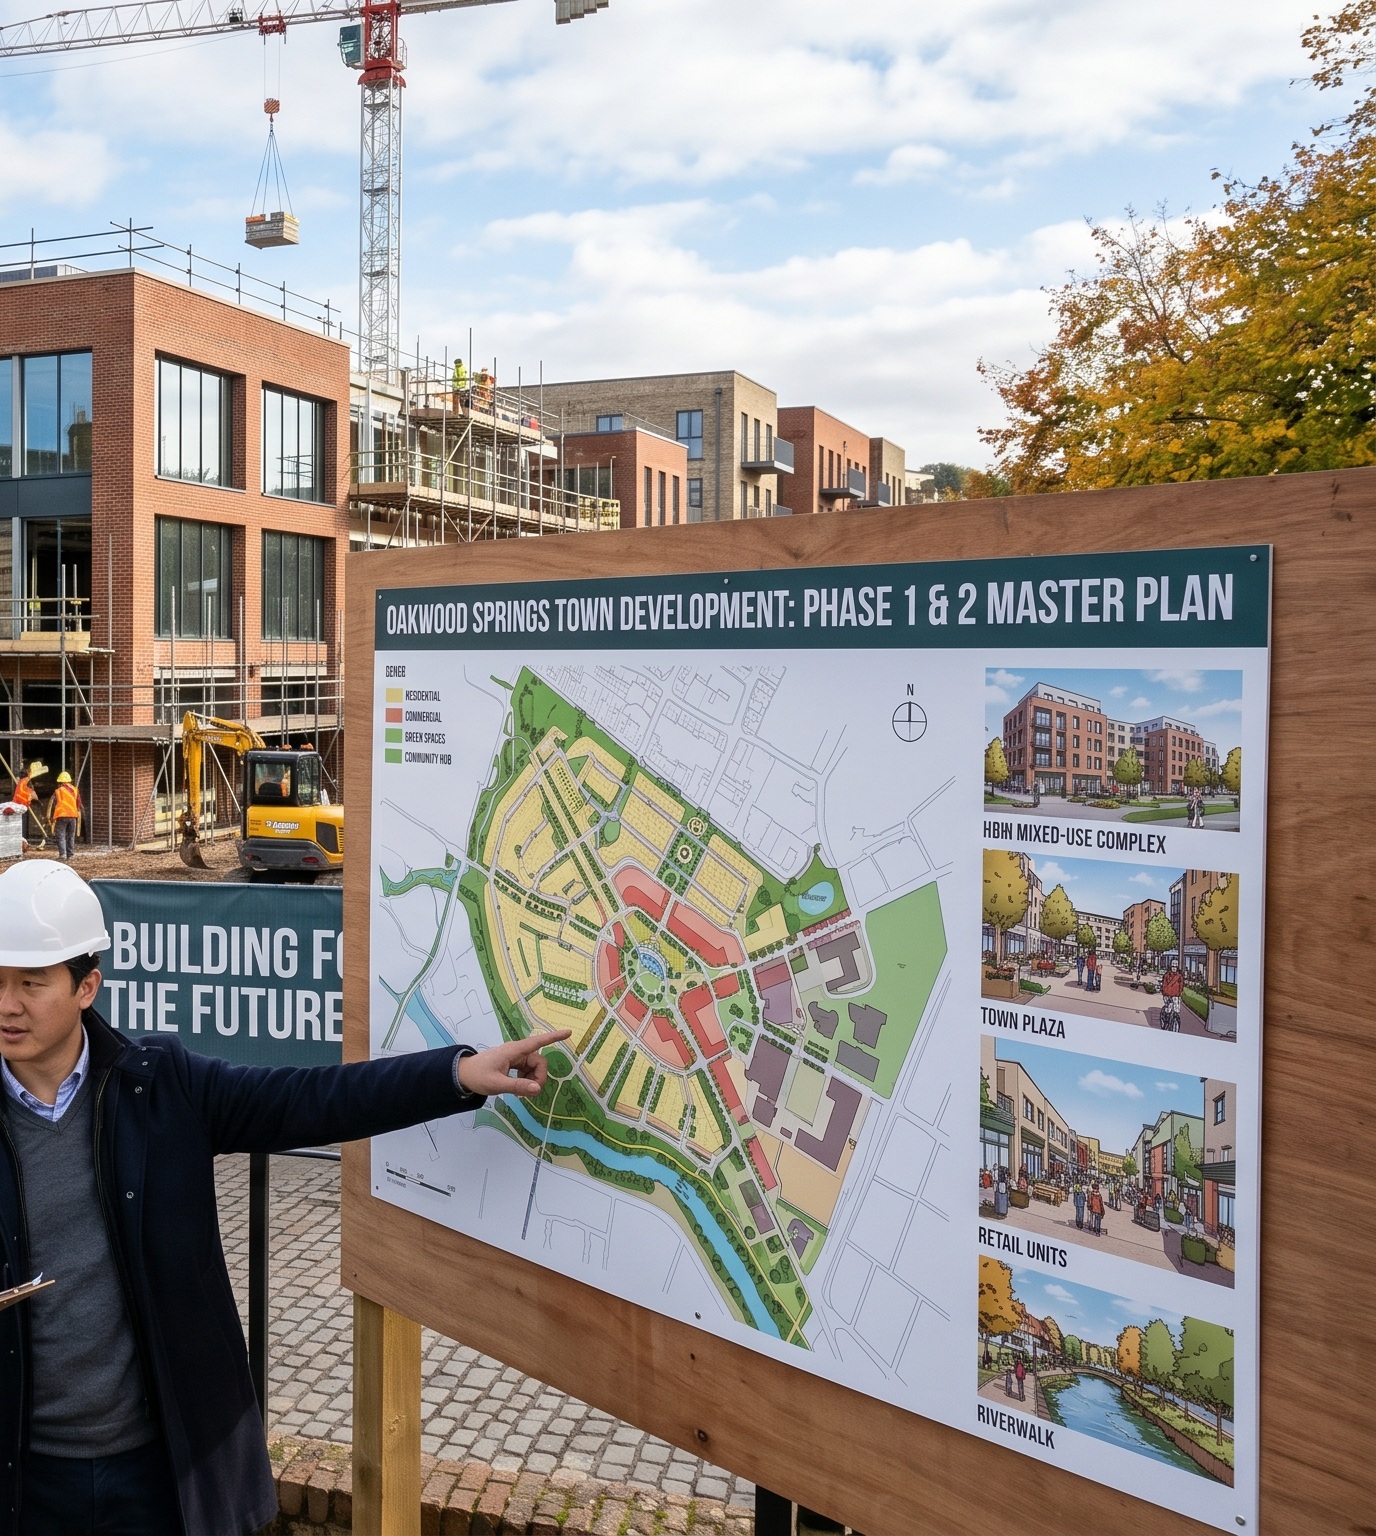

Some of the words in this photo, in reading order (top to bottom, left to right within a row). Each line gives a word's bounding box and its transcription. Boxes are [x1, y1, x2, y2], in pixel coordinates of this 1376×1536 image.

[385, 602, 468, 636] OAKWOOD
[472, 598, 551, 634] SPRINGS
[555, 595, 614, 632] TOWN
[619, 589, 795, 632] DEVELOPMENT:
[803, 585, 893, 628] PHASE
[904, 584, 916, 626] 1
[928, 584, 950, 626] &
[958, 582, 978, 626] 2
[987, 577, 1124, 625] MASTER
[1136, 573, 1234, 622] PLAN
[906, 684, 914, 696] N
[1016, 824, 1093, 847] MIXED-USE
[1096, 829, 1167, 855] COMPLEX
[113, 921, 298, 979] BUILDING
[103, 979, 179, 1033] THE
[192, 984, 343, 1042] FUTURE
[981, 1006, 1018, 1030] TOWN
[1022, 1014, 1066, 1039] PLAZA
[978, 1226, 1024, 1256] RETAIL
[1026, 1240, 1068, 1268] UNITS
[977, 1404, 1055, 1450] RIVERWALK
